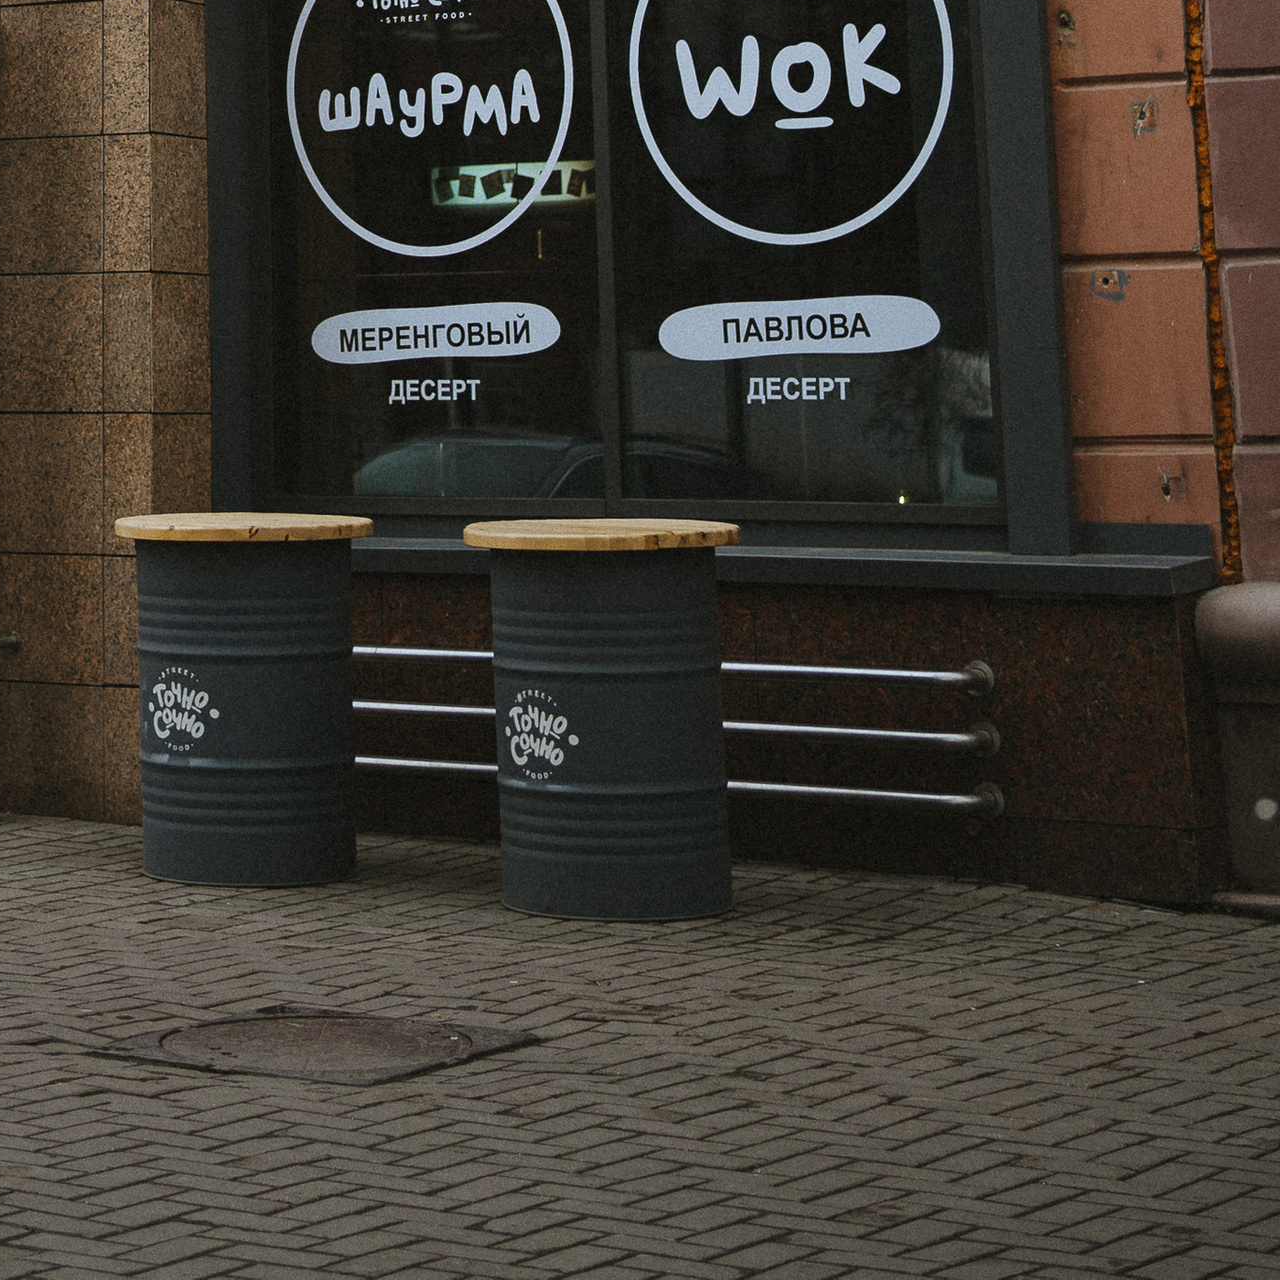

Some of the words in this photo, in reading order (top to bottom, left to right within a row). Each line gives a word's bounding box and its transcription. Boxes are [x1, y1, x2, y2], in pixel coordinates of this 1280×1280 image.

[385, 14, 428, 24] STREET
[435, 11, 465, 20] FOOD
[675, 23, 901, 129] WOK
[339, 312, 532, 354] МЕРЕНГОВЫЙ
[722, 313, 872, 346] ПАВЛОВА
[389, 378, 481, 405] ДЕСЕРТ
[746, 376, 851, 405] ДЕСЕРТ
[161, 667, 196, 679] STREET
[517, 689, 553, 703] STREET
[167, 742, 190, 752] FOOD
[526, 769, 549, 779] FOOD
